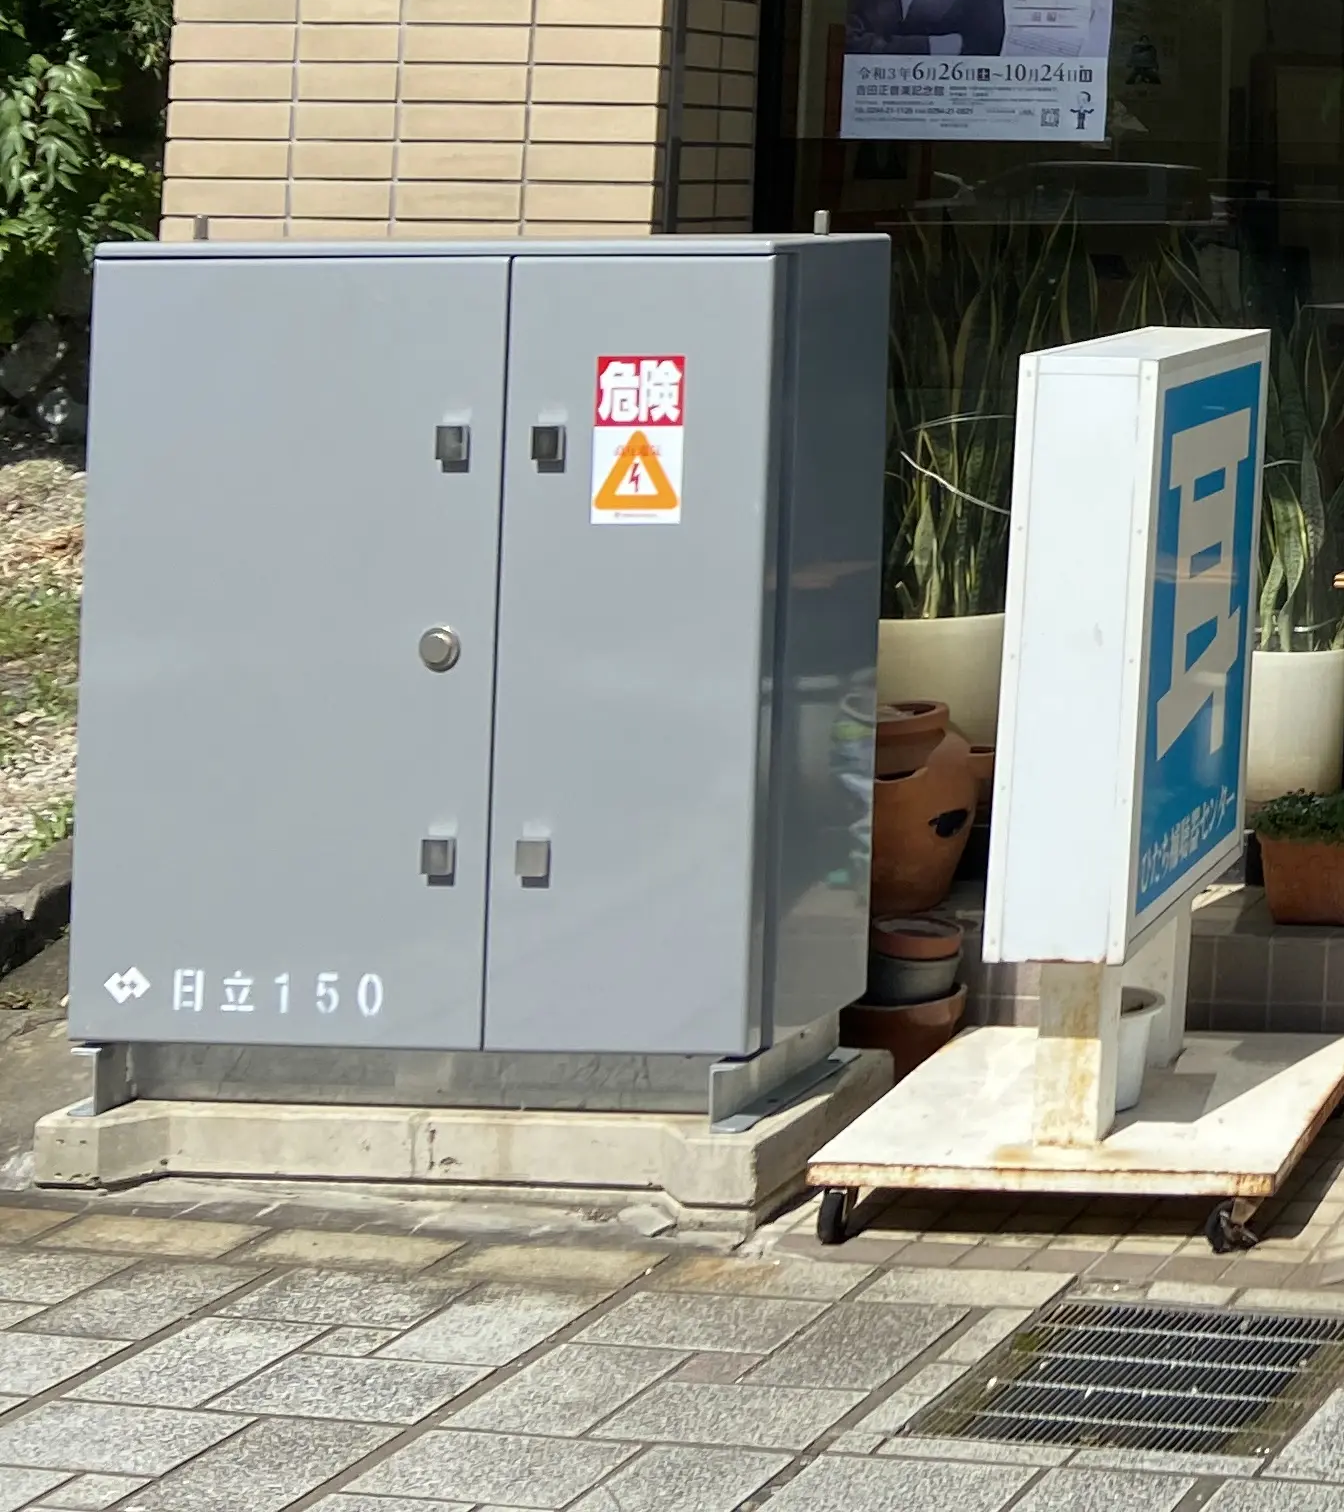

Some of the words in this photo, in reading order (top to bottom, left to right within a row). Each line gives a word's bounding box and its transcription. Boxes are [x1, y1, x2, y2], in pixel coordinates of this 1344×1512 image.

[597, 359, 683, 423] 危険
[1155, 406, 1251, 763] 耳
[1140, 784, 1236, 894] ひたち補聴器センター
